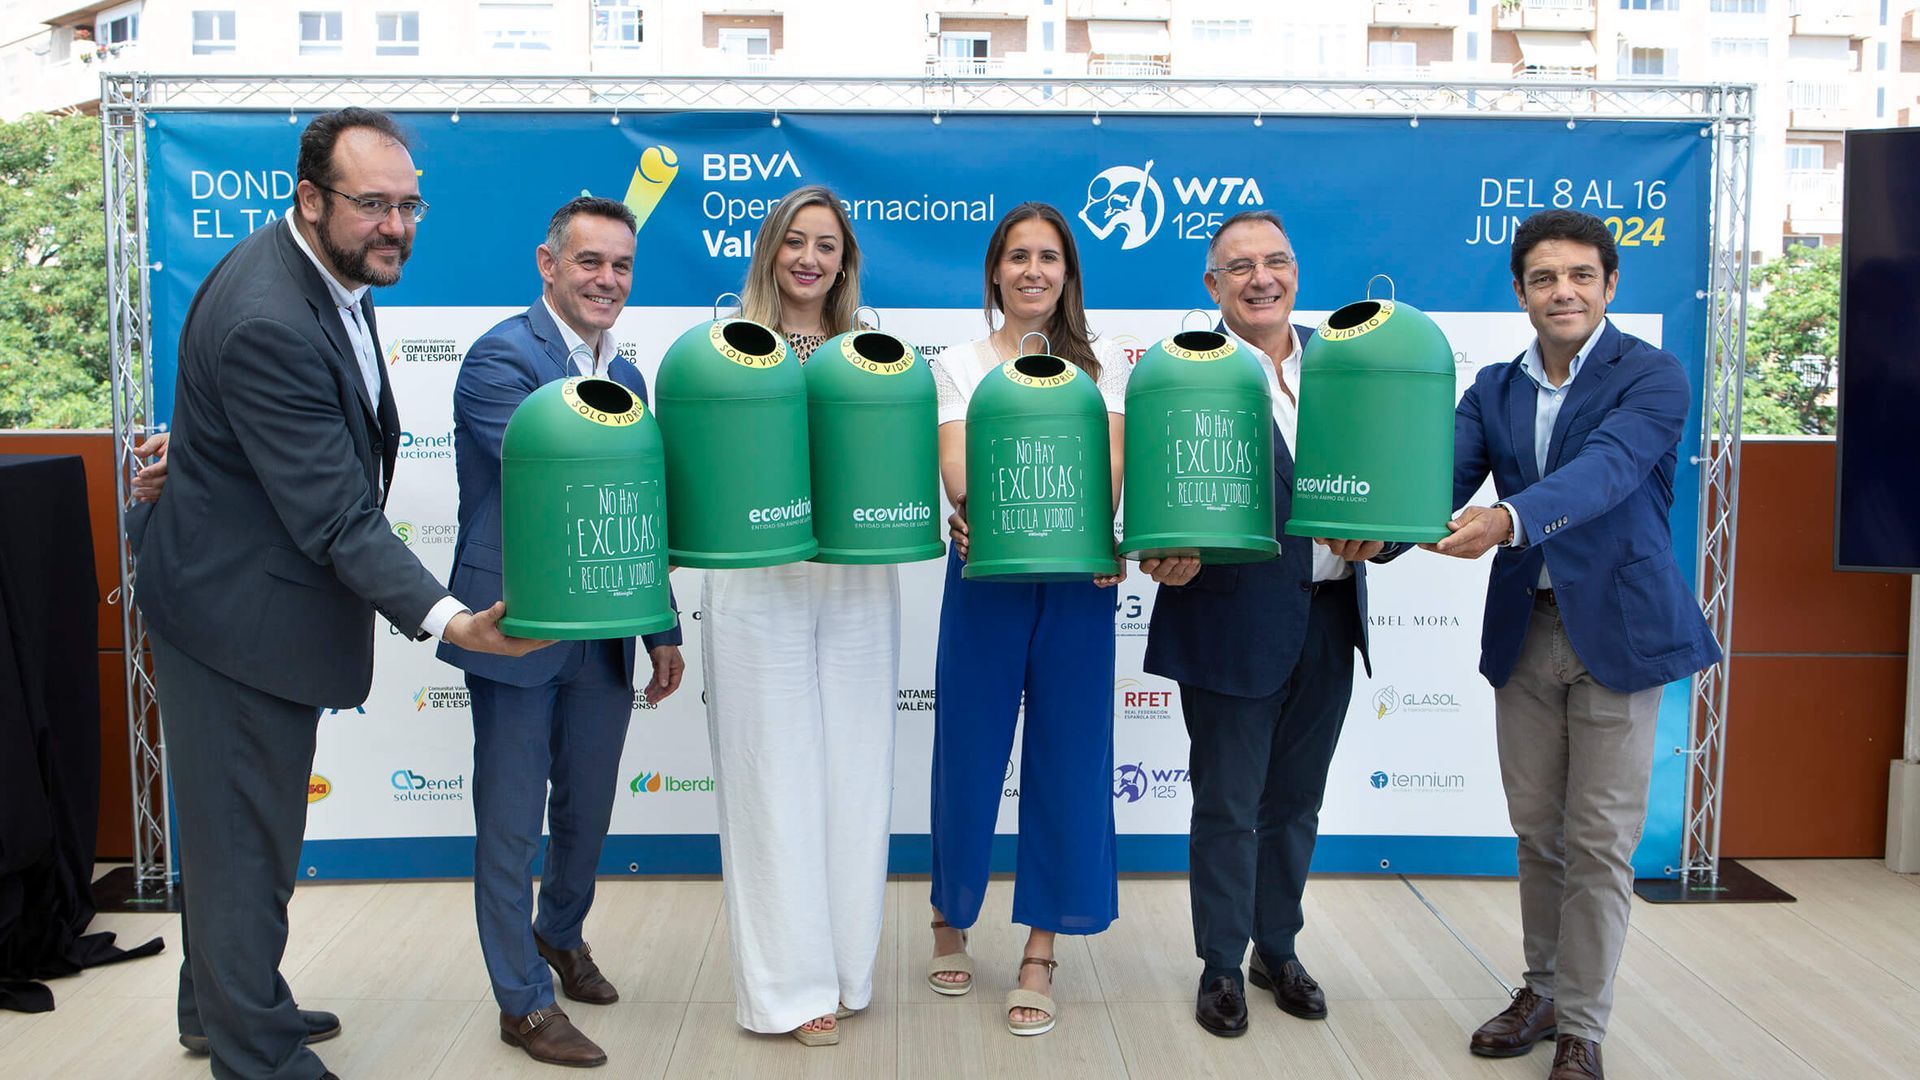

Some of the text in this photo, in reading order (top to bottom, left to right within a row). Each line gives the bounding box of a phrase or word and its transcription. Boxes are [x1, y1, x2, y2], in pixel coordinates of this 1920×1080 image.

[703, 150, 802, 181] BBVA
[191, 170, 294, 200] DOND
[1172, 176, 1264, 206] WTA
[1480, 178, 1667, 210] DEL 8 AL 16
[845, 193, 995, 222] ernacional
[193, 209, 234, 239] EL
[1172, 212, 1224, 240] 125
[1603, 216, 1666, 247] 024
[702, 229, 754, 259] Val
[1335, 318, 1379, 339] VIDRIO
[401, 345, 456, 353] COMUNITAT
[406, 353, 463, 362] DE L'ESPORT
[617, 349, 637, 357] DAD
[719, 344, 754, 367] SOLO
[915, 345, 949, 356] MENT
[1165, 342, 1192, 359] SOLO
[1454, 351, 1473, 364] OL
[847, 351, 878, 372] SOLO
[885, 351, 915, 373] VIDRIO
[1006, 368, 1034, 386] SOLO
[571, 400, 643, 424] SOLO VIDRIO
[1195, 412, 1235, 439] NO HAY
[397, 448, 452, 459] uciones
[1016, 439, 1055, 465] NO HAY
[1175, 438, 1252, 475] EXCUSAS
[999, 464, 1076, 502] EXCUSAS
[1178, 481, 1251, 506] RECICLA VIDRIO
[1296, 473, 1371, 496] ecovidrio
[599, 487, 639, 516] NO HAY
[748, 496, 812, 523] ecovidrio
[852, 501, 931, 522] ecovidrio
[1002, 506, 1074, 531] RECICLA VIDRIO
[421, 525, 457, 535] SPORT
[421, 536, 442, 544] CLUB
[577, 513, 655, 557] EXCUSAS
[581, 560, 655, 591] RECICLA VIDRIO
[1368, 615, 1459, 626] ABEL MORA
[428, 692, 470, 700] COMUNIT
[896, 690, 936, 698] NTAME
[1124, 691, 1172, 708] RFET
[1402, 693, 1461, 706] GLASOL
[631, 702, 658, 710] ONSO
[309, 783, 327, 795] sa
[665, 775, 716, 792] Iberdr
[1392, 771, 1465, 788] tennium
[393, 790, 464, 802] soluciones
[1003, 788, 1019, 798] CA
[1151, 785, 1177, 799] 125
